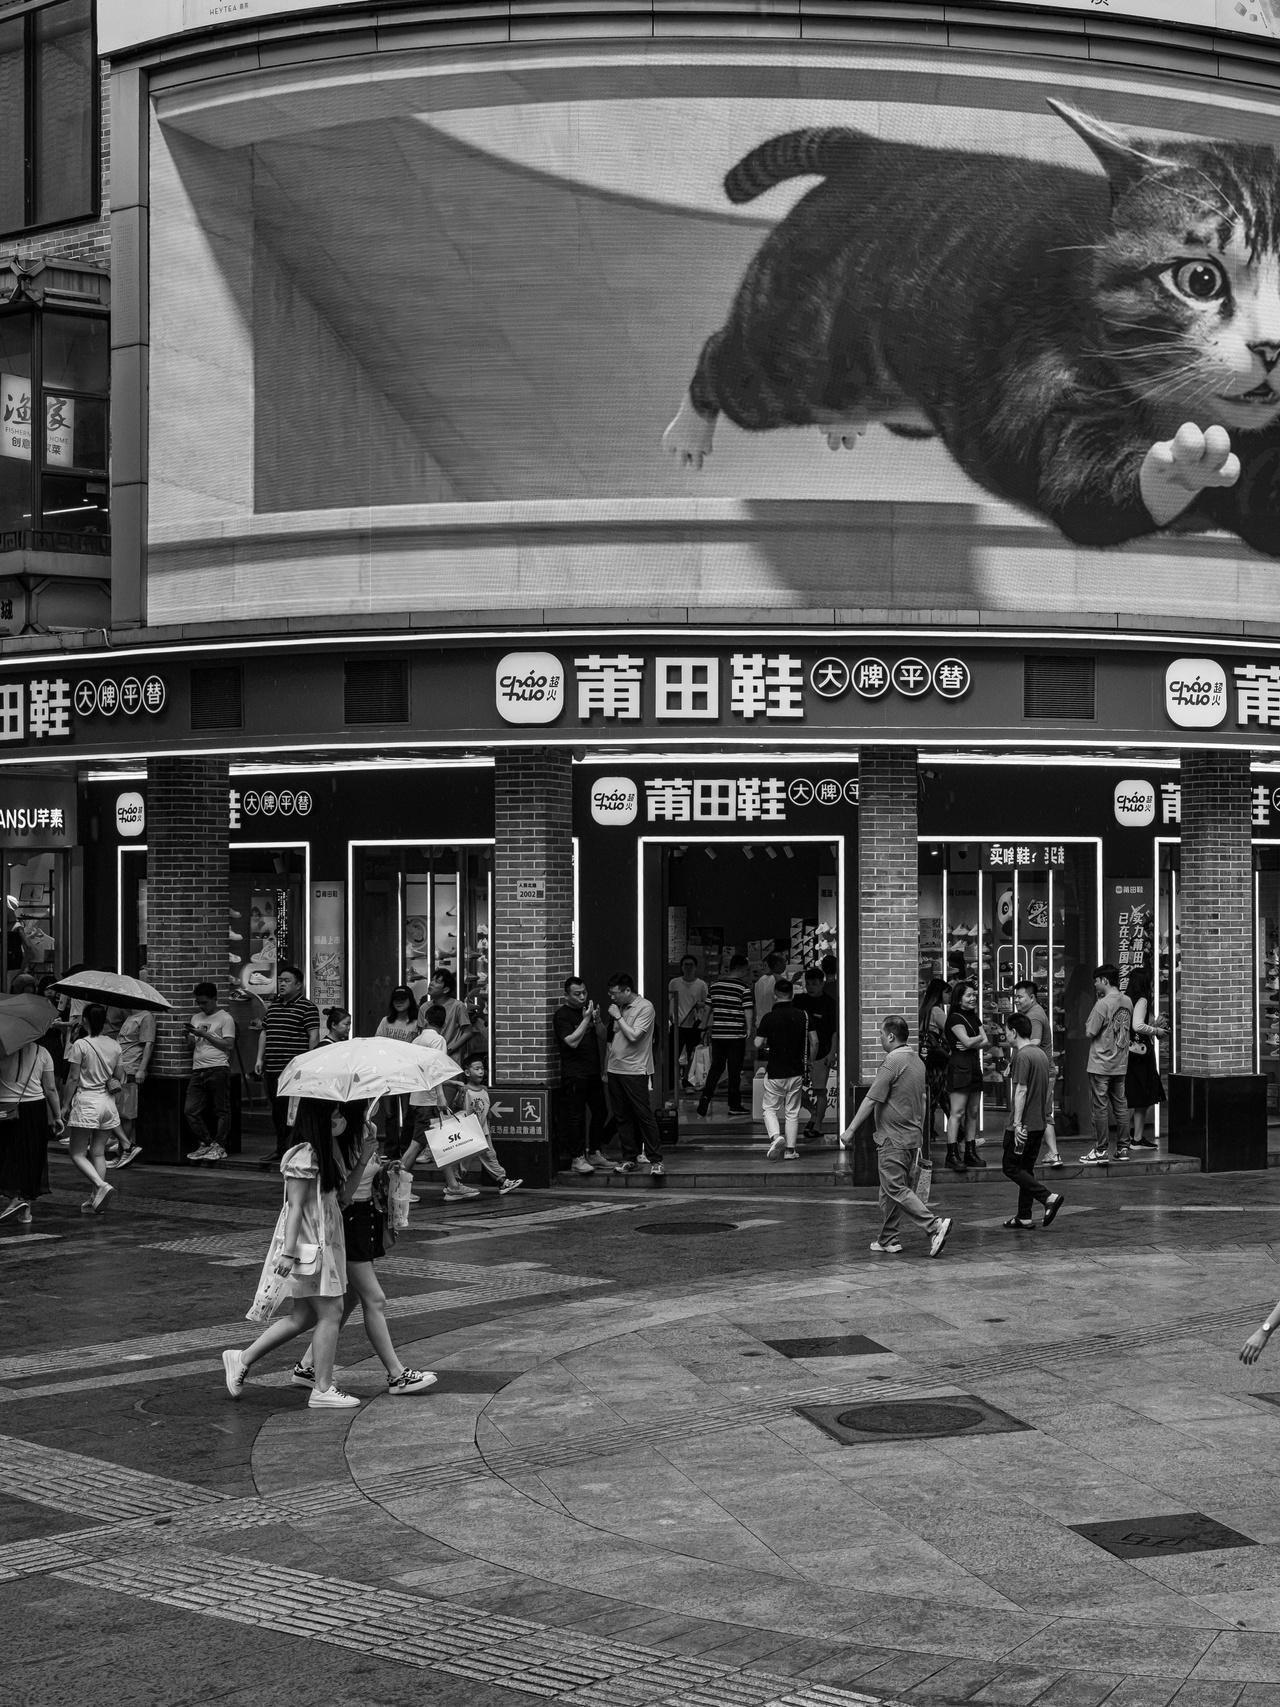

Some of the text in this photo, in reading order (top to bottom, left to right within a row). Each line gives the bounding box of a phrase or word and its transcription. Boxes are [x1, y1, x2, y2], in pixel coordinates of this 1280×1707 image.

[210, 5, 237, 15] HEYTEA
[49, 436, 69, 445] HOME
[77, 678, 163, 711] 大牌平替
[574, 653, 967, 719] 莆田鞋 大牌平替
[245, 792, 310, 814] 大牌平替
[644, 778, 786, 821] 莆田鞋
[519, 890, 536, 898] 2002
[1132, 913, 1144, 968] 实力莆田
[447, 1132, 461, 1144] SK
